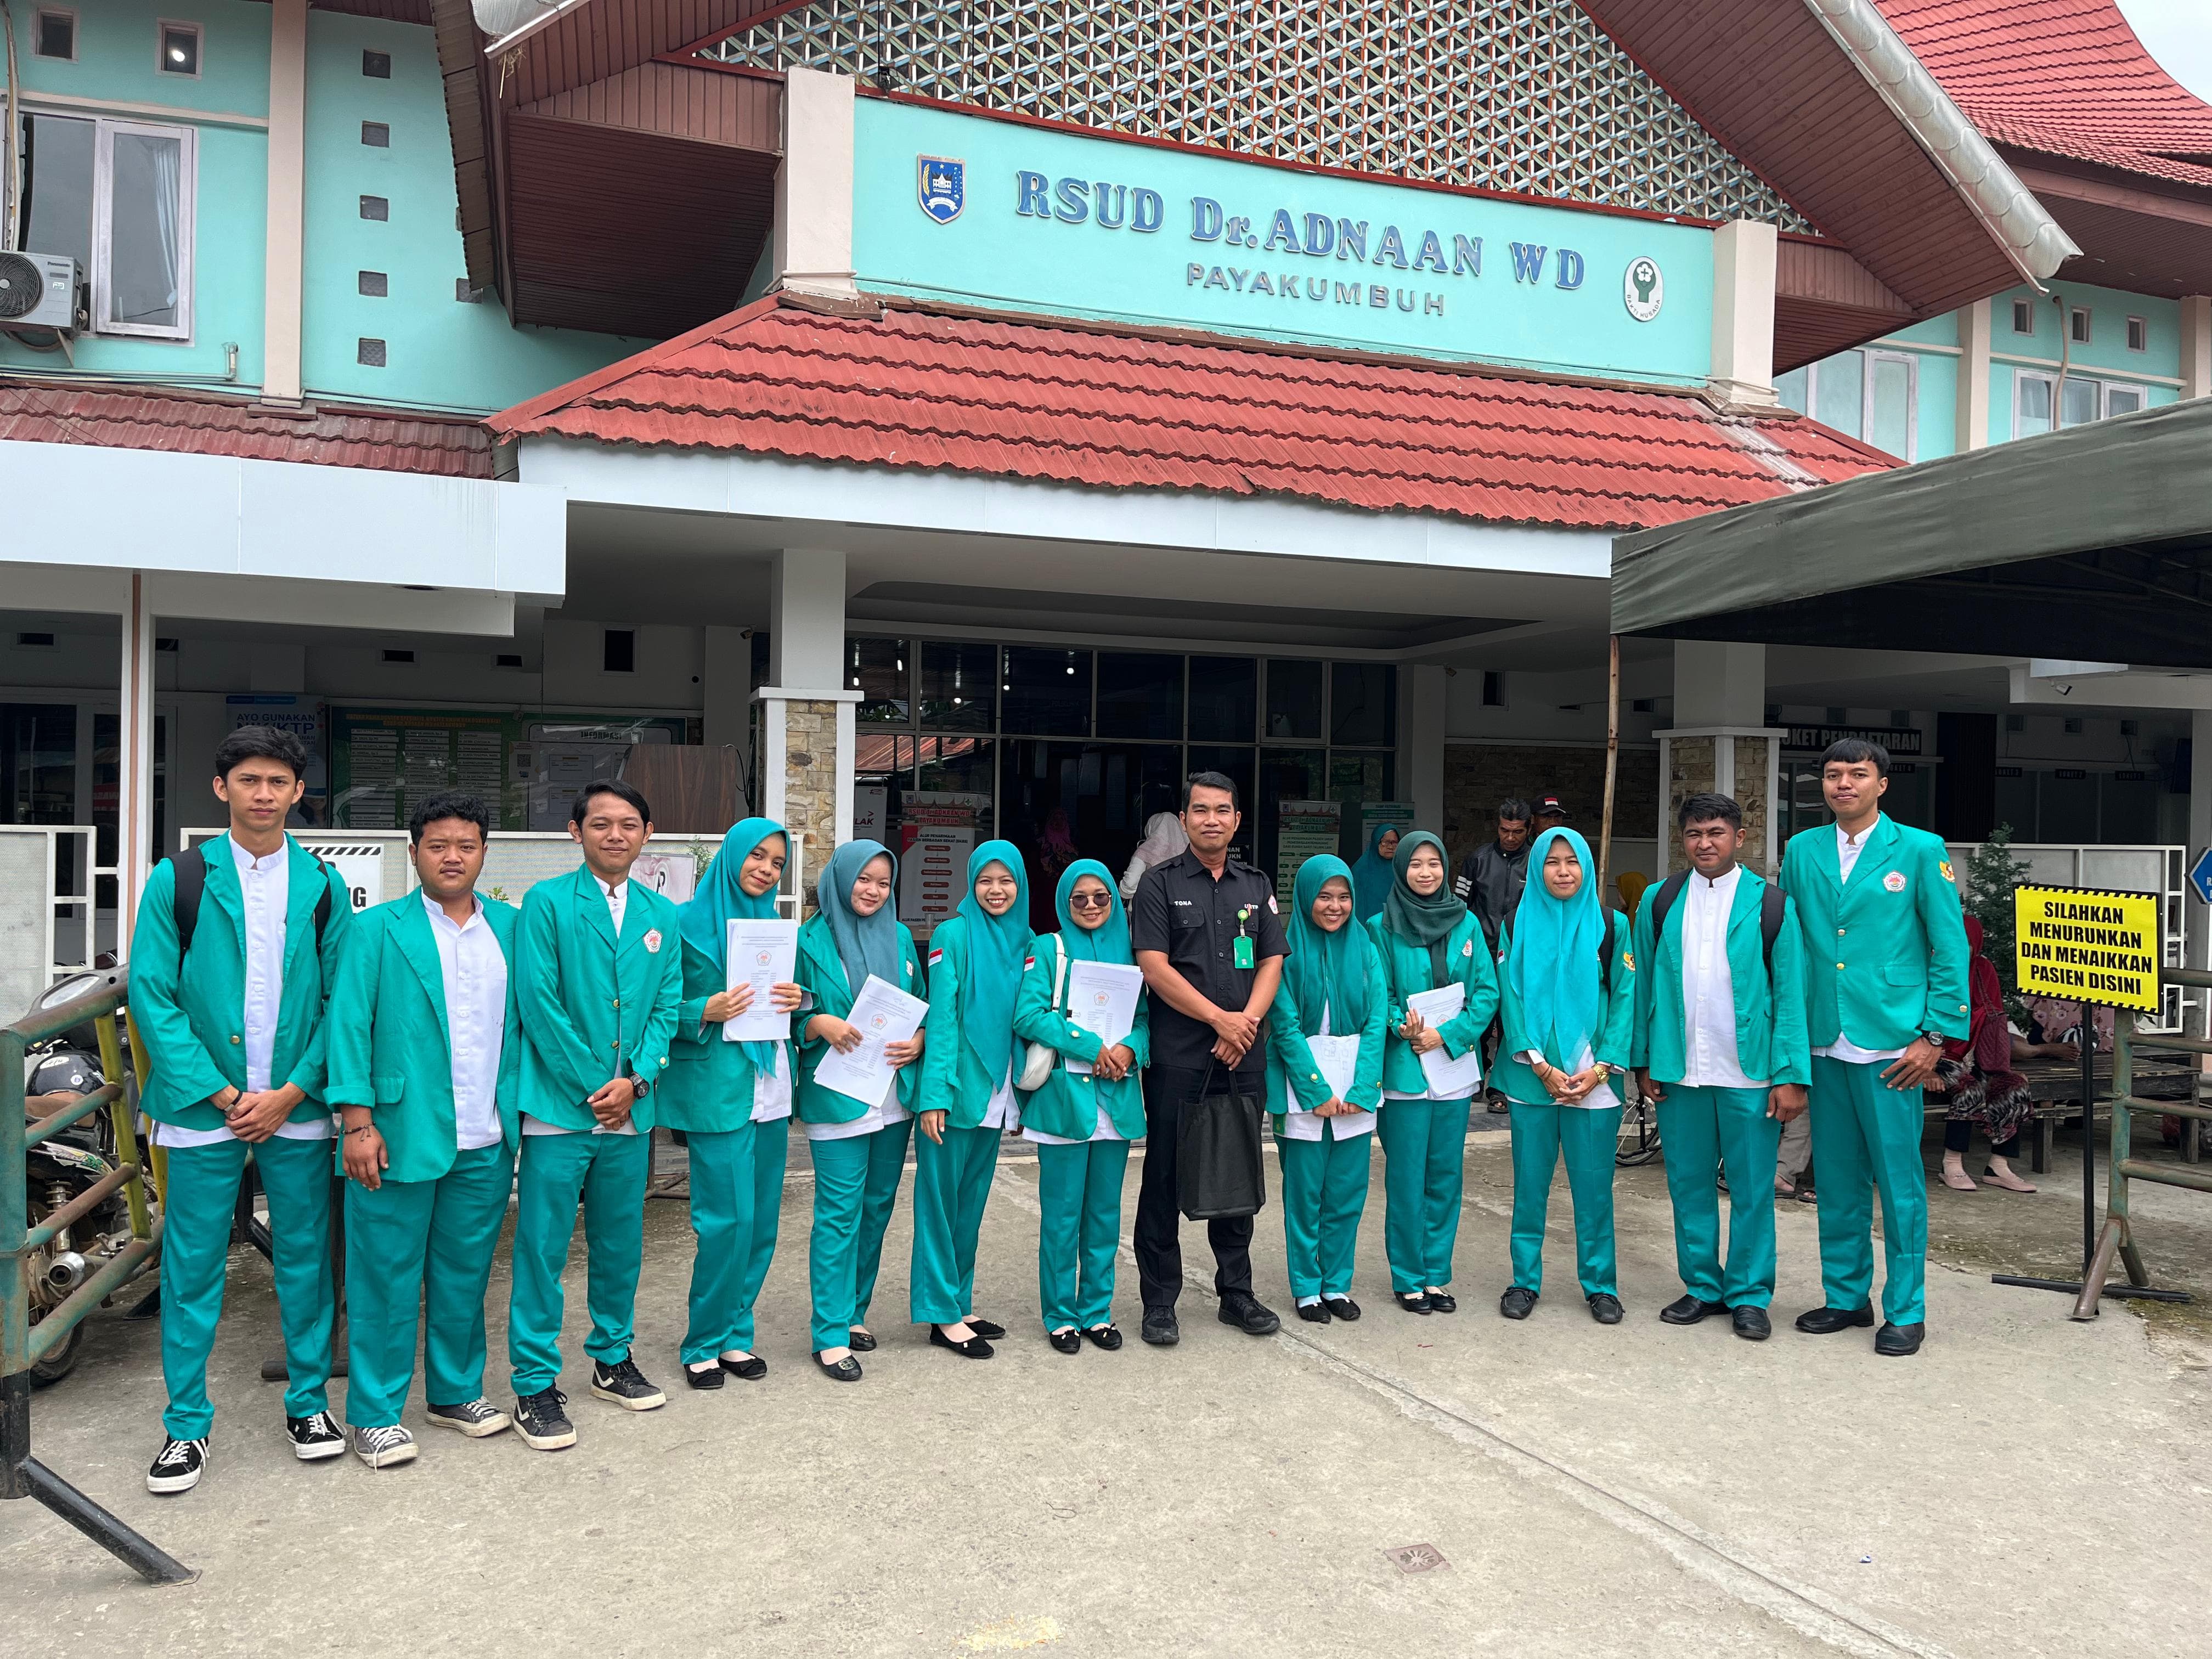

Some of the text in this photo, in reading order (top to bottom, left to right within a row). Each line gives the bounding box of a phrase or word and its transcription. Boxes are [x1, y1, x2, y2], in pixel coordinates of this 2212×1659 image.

[1016, 170, 1164, 232] RSUD
[1187, 262, 1444, 316] PAYAKUMBUH
[1627, 294, 1661, 318] BAKTI HUSADA
[580, 731, 622, 740] INFORMASI
[1781, 729, 1818, 746] OKET
[2044, 901, 2123, 924] SILAHKAN
[2029, 921, 2141, 949] MENURUNKAN
[2021, 941, 2152, 974] DAN MENAIKKAN
[2030, 964, 2141, 995] PASIEN DISINI
